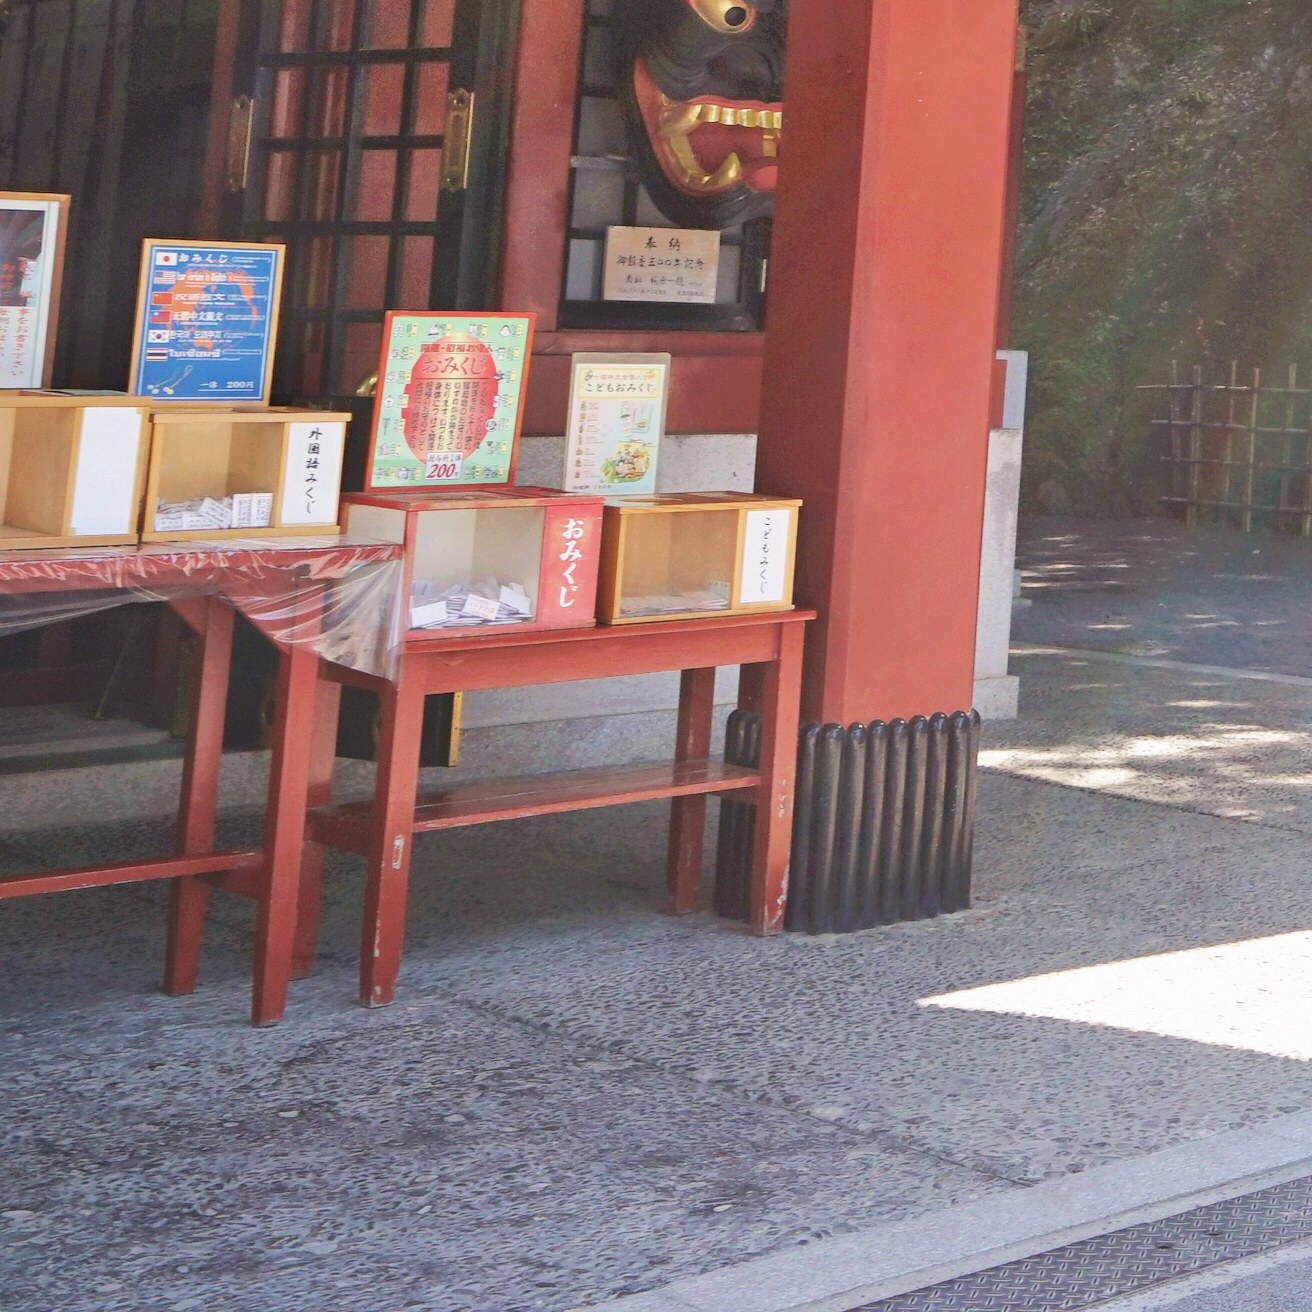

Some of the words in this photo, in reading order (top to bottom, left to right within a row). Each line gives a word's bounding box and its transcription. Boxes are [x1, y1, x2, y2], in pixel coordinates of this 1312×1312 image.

[177, 252, 229, 264] おみくじ
[421, 356, 485, 376] おみくじ
[585, 382, 657, 393] こどもおみくじ
[305, 427, 323, 514] 外国語みくじ
[559, 517, 585, 608] おみくじ
